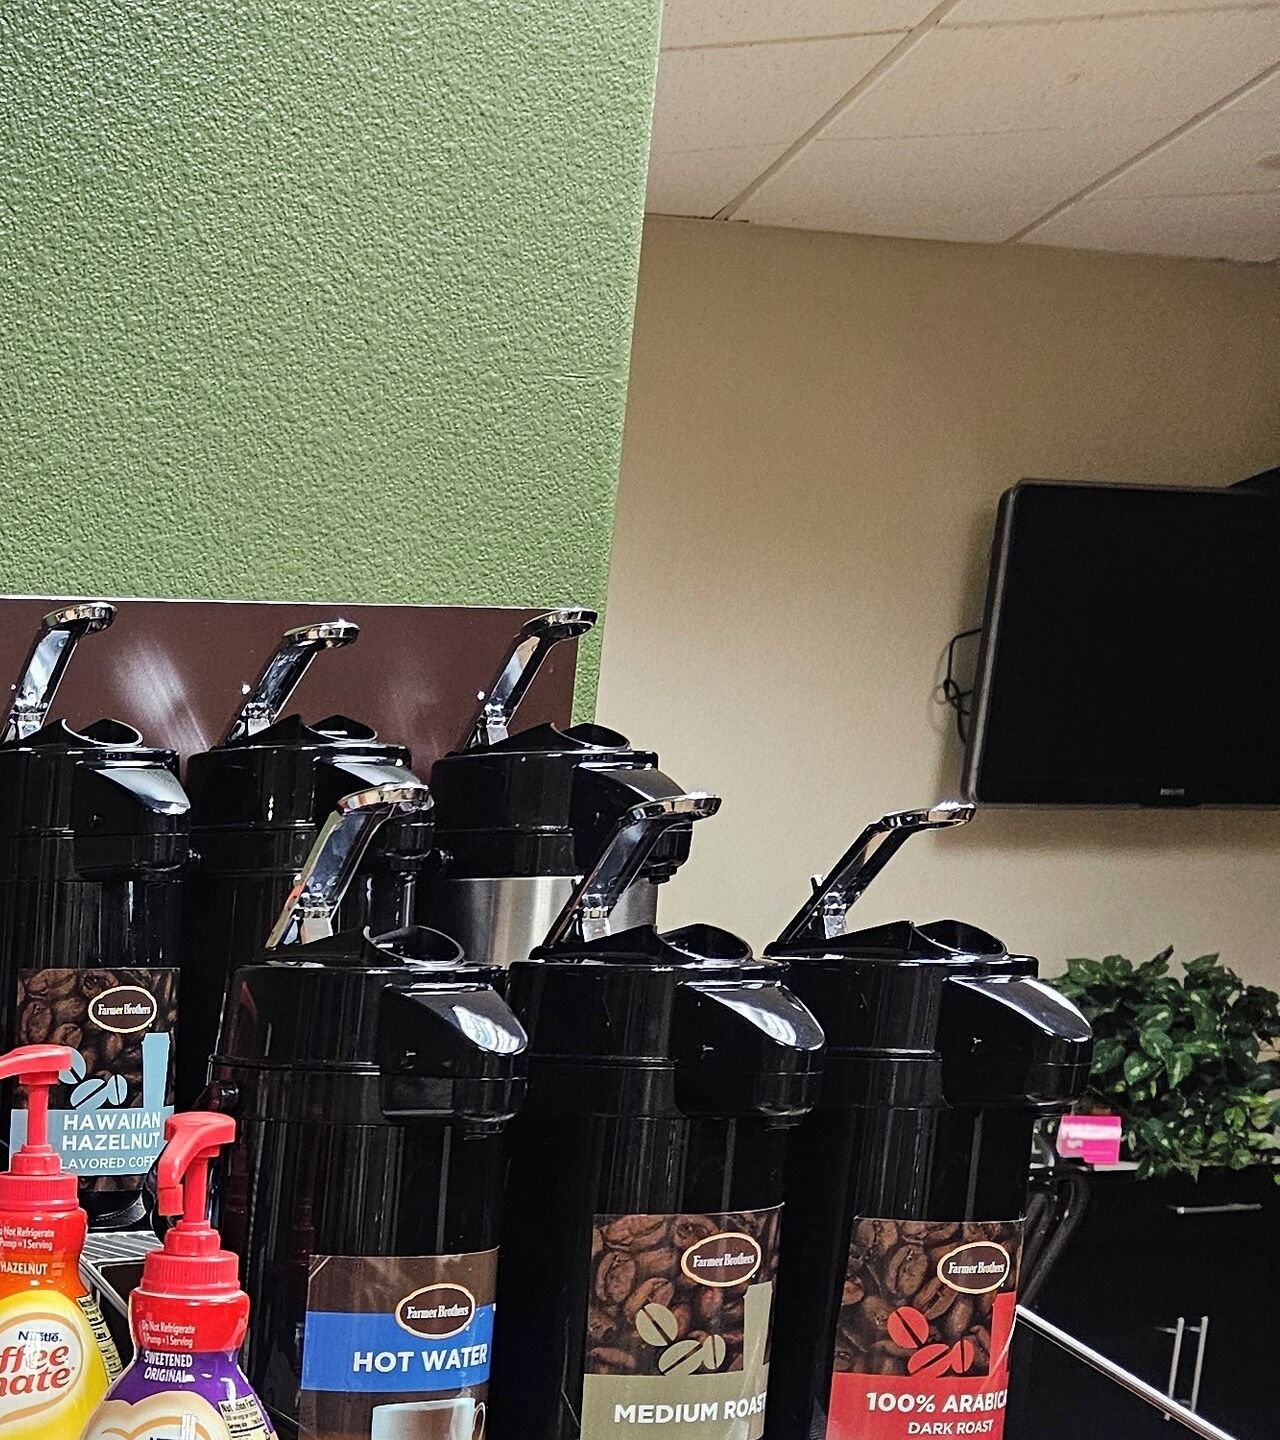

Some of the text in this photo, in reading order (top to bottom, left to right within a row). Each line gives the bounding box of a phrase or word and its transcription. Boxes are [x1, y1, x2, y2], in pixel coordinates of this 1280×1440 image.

[97, 1003, 151, 1016] Farmer Brothers
[63, 1111, 161, 1131] HAWAIIAN
[62, 1132, 160, 1151] HAZELNUT
[59, 1154, 157, 1170] LAVORED COFF
[4, 1226, 16, 1236] Not
[17, 1226, 55, 1238] Refrigerate
[0, 1238, 17, 1249] Pump
[27, 1239, 53, 1251] Serving
[0, 1261, 48, 1275] HAZELNUT
[693, 1253, 755, 1268] Farmer Brothers
[947, 1262, 1005, 1275] Farmer Brothers
[407, 1305, 469, 1320] Farmer Brothers
[150, 1321, 160, 1331] Not
[161, 1321, 195, 1335] Refrigerate
[170, 1335, 193, 1349] Serving
[144, 1350, 193, 1368] SWEETENED
[353, 1343, 488, 1373] HOT WATER
[144, 1367, 187, 1383] ORIGINAL
[613, 1391, 767, 1424] MEDIUM ROAST
[866, 1389, 1008, 1413] 100% ARABIC
[907, 1419, 994, 1435] DARK ROAST
